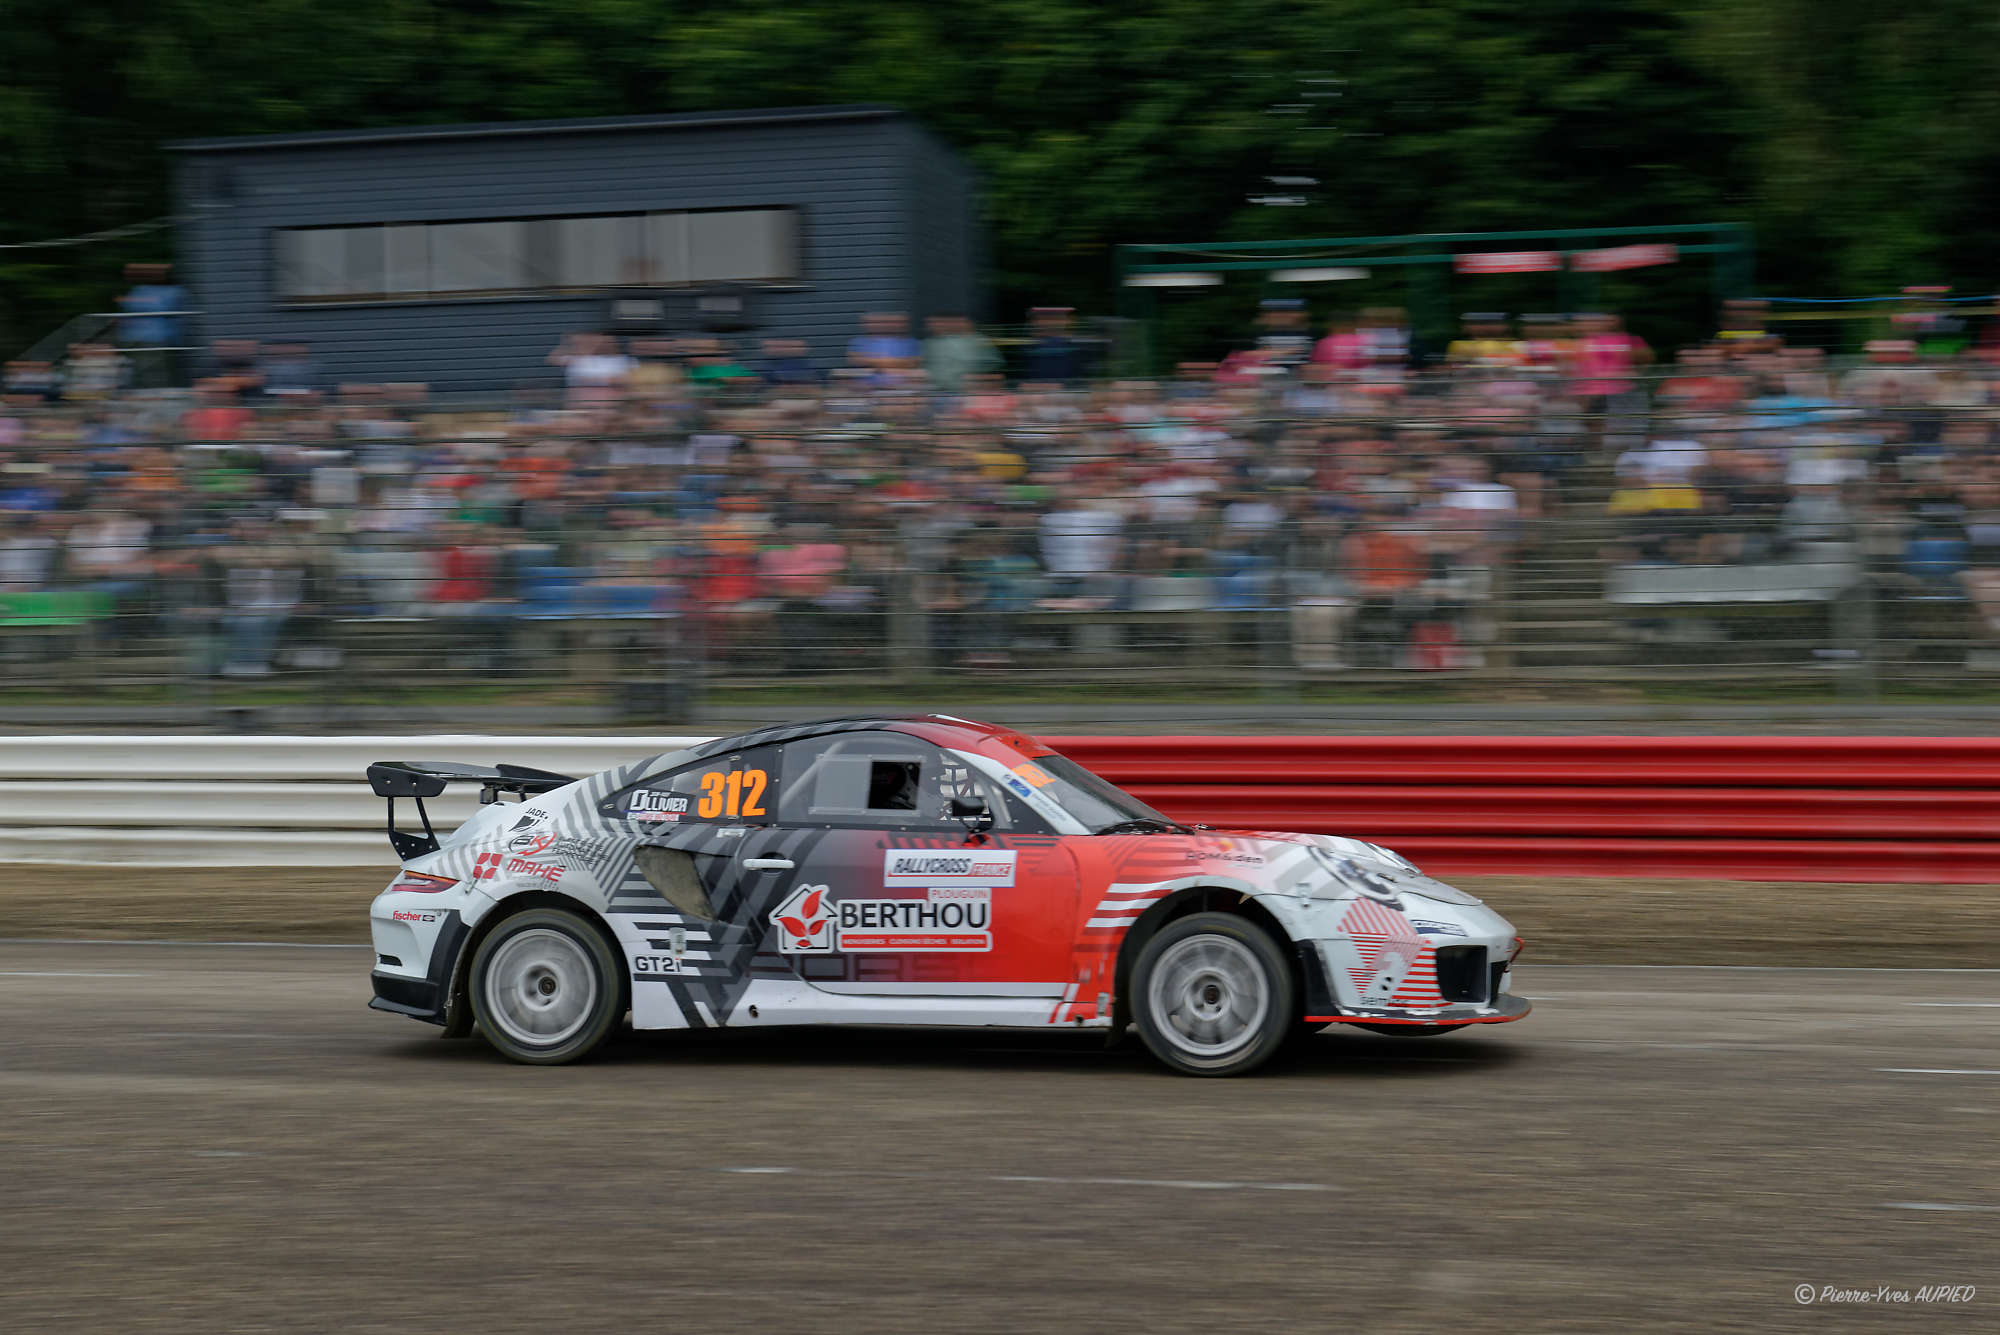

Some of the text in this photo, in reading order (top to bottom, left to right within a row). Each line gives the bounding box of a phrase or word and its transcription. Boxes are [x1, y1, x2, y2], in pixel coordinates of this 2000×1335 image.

[630, 789, 688, 812] OLLIVIER
[697, 769, 767, 819] 312
[893, 858, 971, 873] RALLYCROSS
[392, 910, 421, 921] fischer
[840, 903, 986, 928] BERTHOU
[635, 956, 681, 972] GT2i
